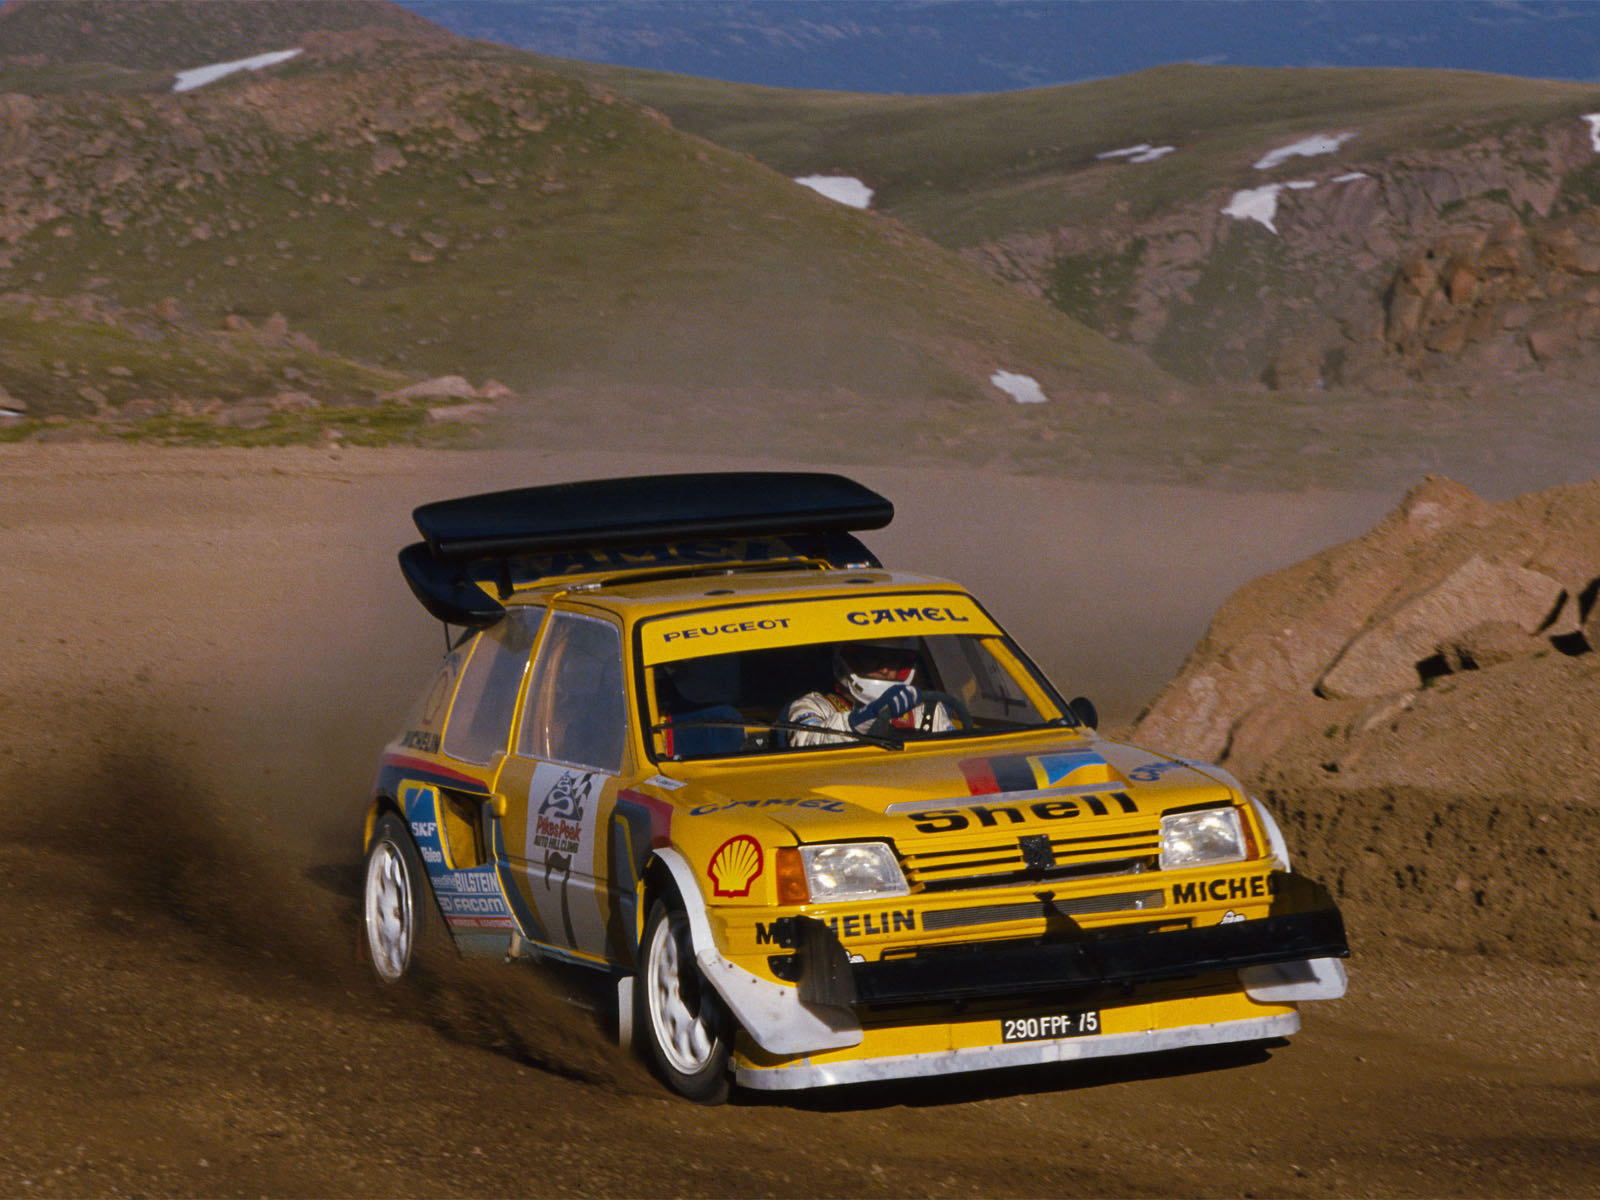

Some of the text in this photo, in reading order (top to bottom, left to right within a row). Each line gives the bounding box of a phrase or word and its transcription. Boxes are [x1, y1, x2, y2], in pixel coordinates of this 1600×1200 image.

[847, 606, 969, 626] CAMEL
[662, 618, 791, 643] PEUGEOT
[689, 797, 846, 817] CAMEL
[910, 792, 1139, 834] Shell
[411, 821, 438, 837] SKF
[558, 819, 582, 842] Peak
[454, 872, 500, 893] BILSTEIN
[1172, 874, 1279, 905] MICHEL
[755, 909, 916, 945] MHELIN
